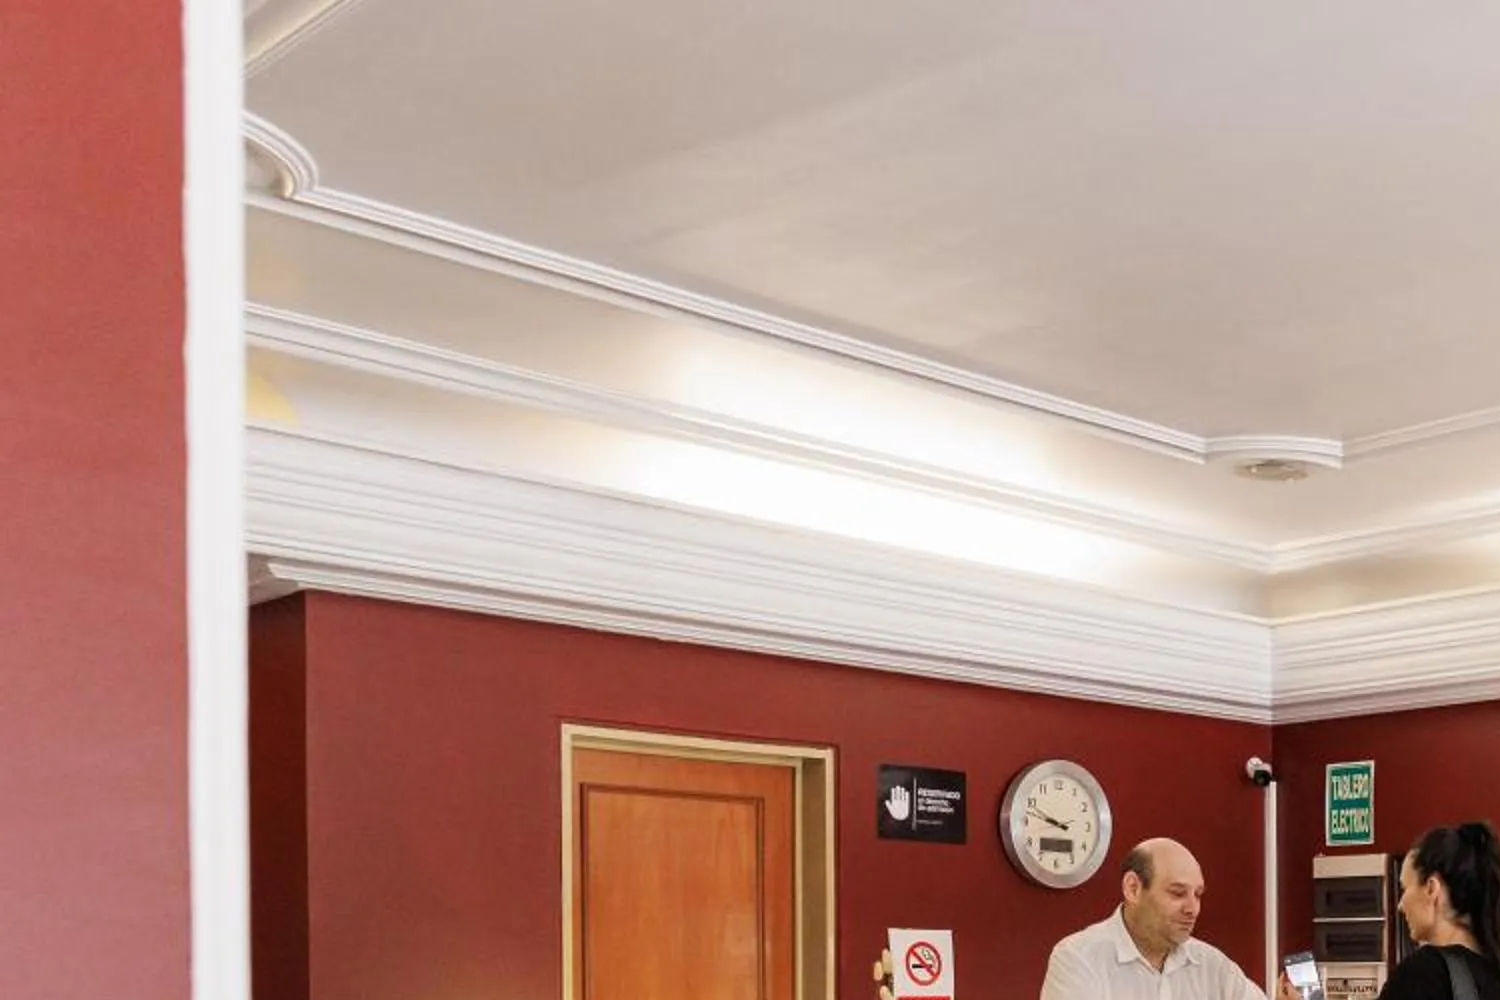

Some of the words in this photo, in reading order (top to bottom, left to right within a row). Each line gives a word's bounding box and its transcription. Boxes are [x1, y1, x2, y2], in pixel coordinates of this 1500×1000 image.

[1039, 784, 1047, 795] 11
[1331, 773, 1369, 801] TABLERO
[1081, 801, 1088, 813] 2
